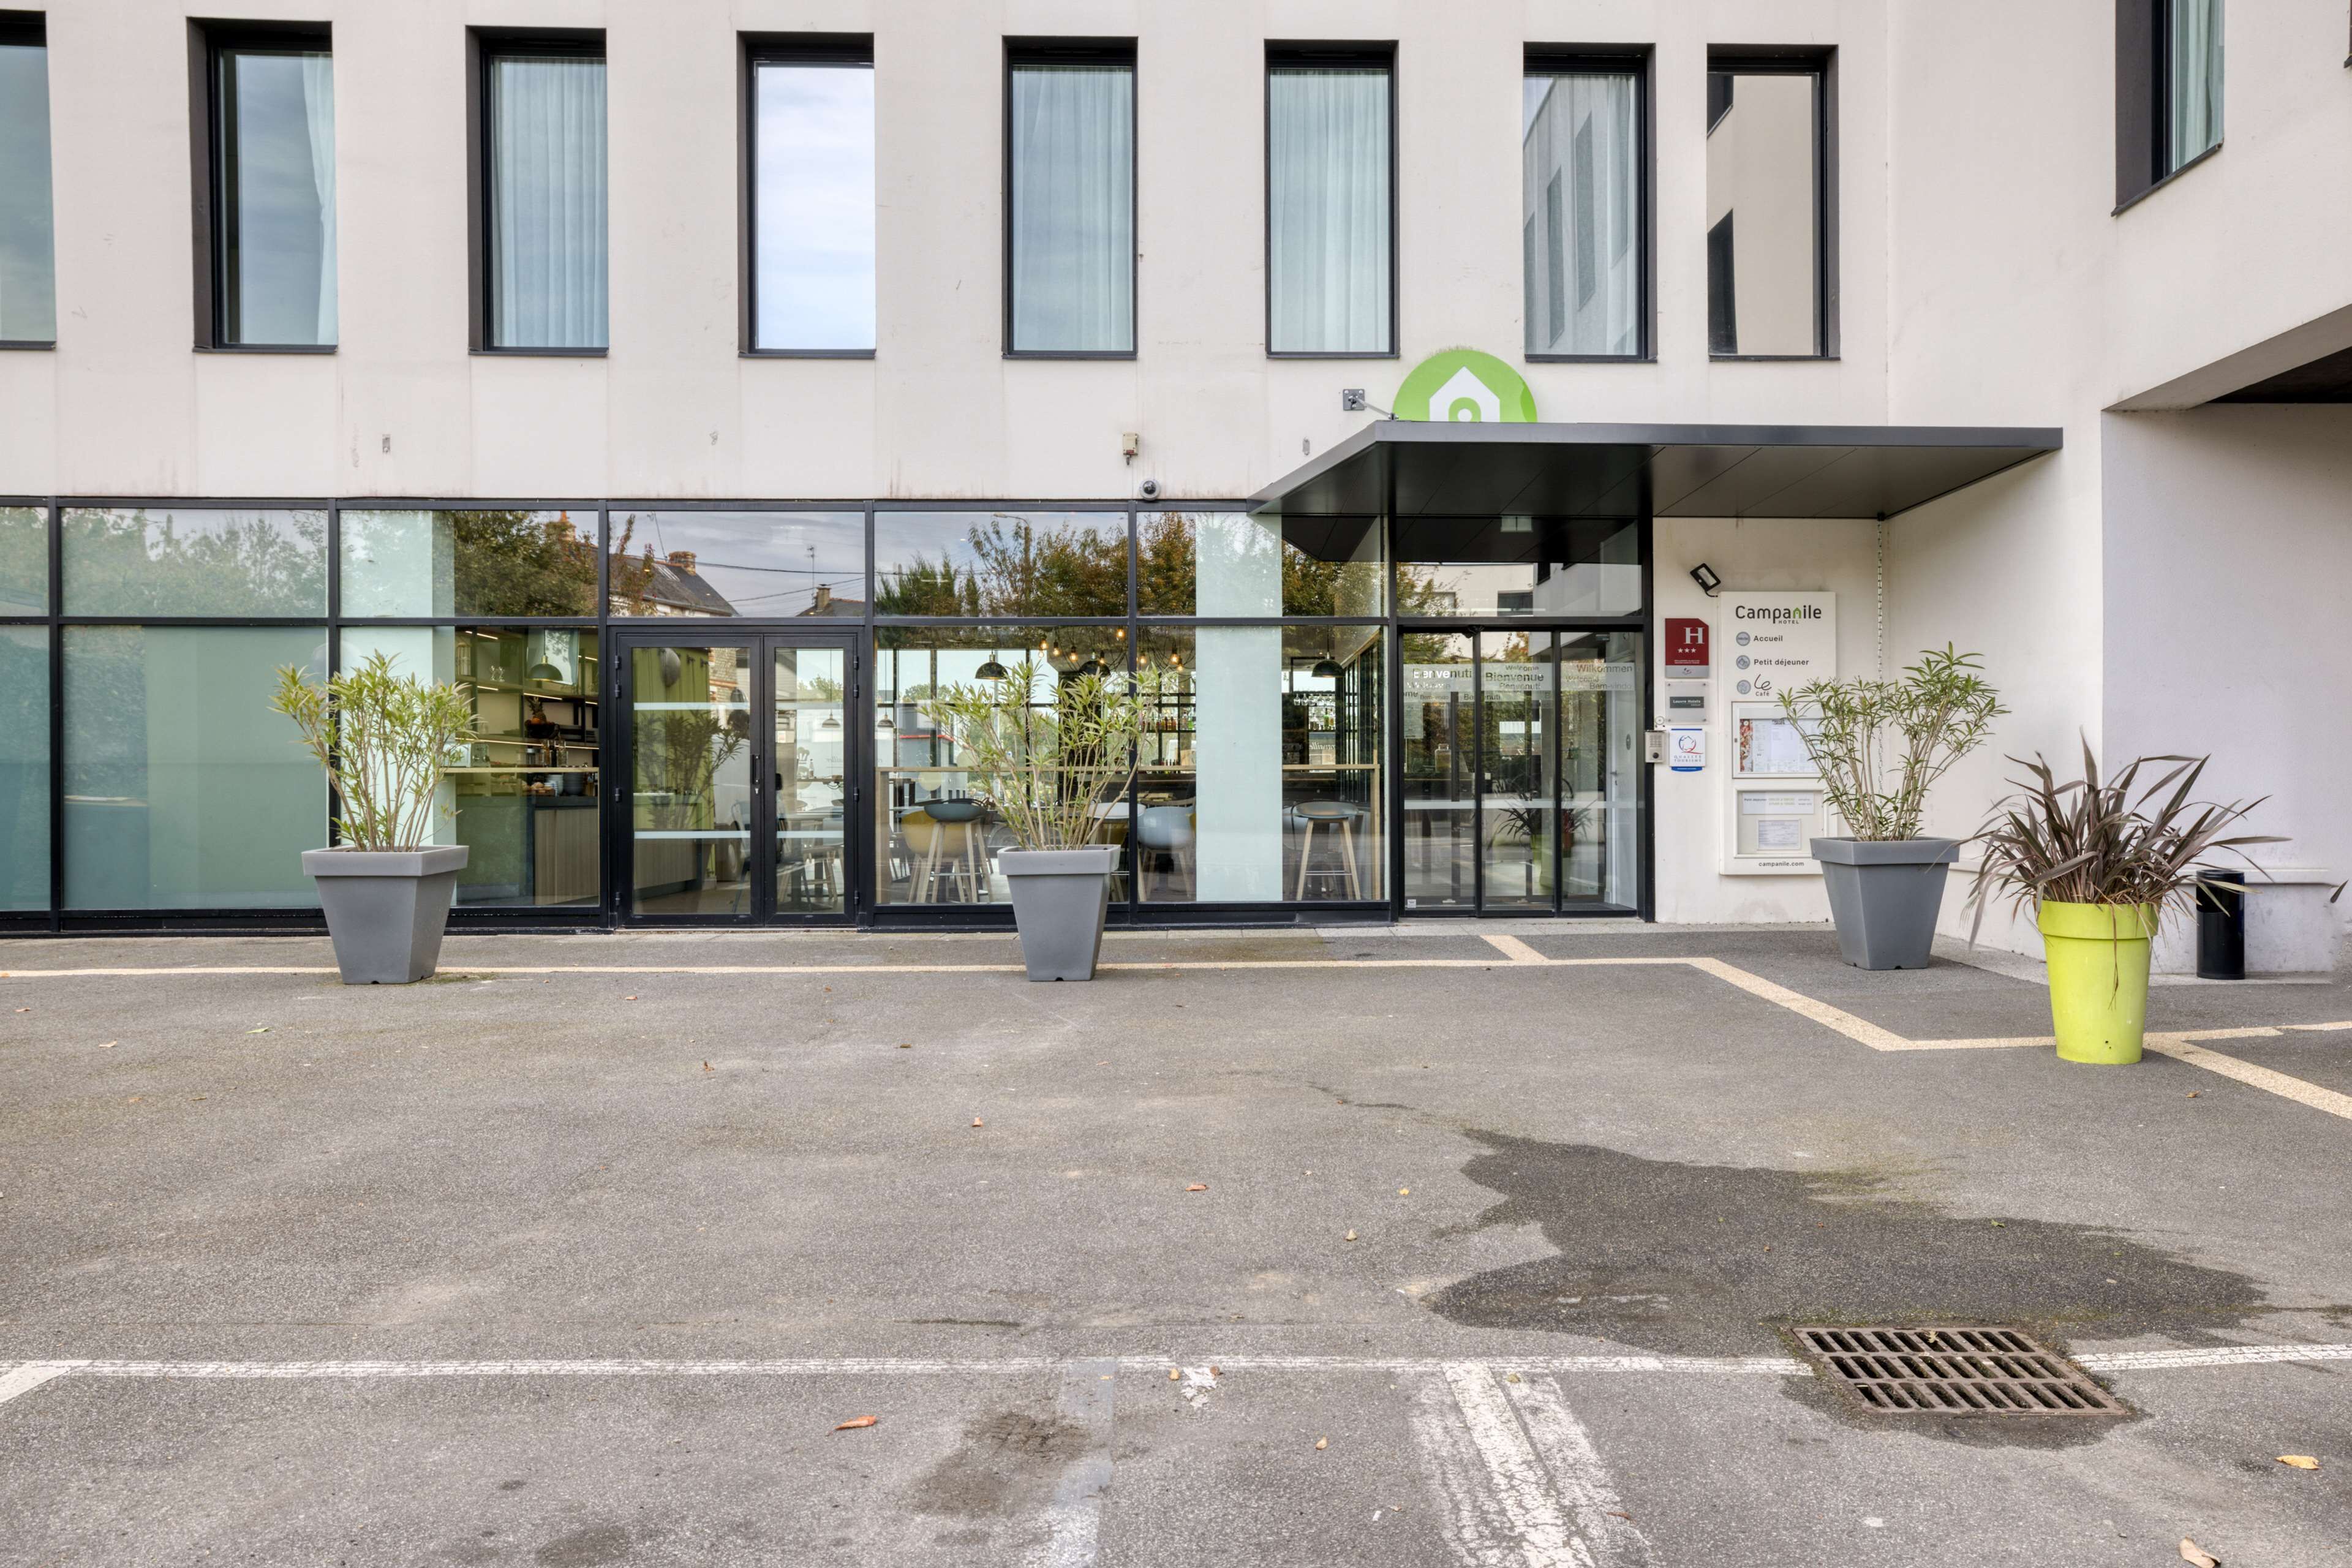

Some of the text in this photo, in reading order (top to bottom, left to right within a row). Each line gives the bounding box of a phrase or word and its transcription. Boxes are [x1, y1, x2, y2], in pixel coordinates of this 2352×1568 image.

[1735, 605, 1822, 624] Campanile
[1683, 627, 1705, 644] H
[1774, 658, 1809, 667] déjeuner
[1485, 672, 1544, 682] Bienvenue
[1754, 674, 1773, 691] Le
